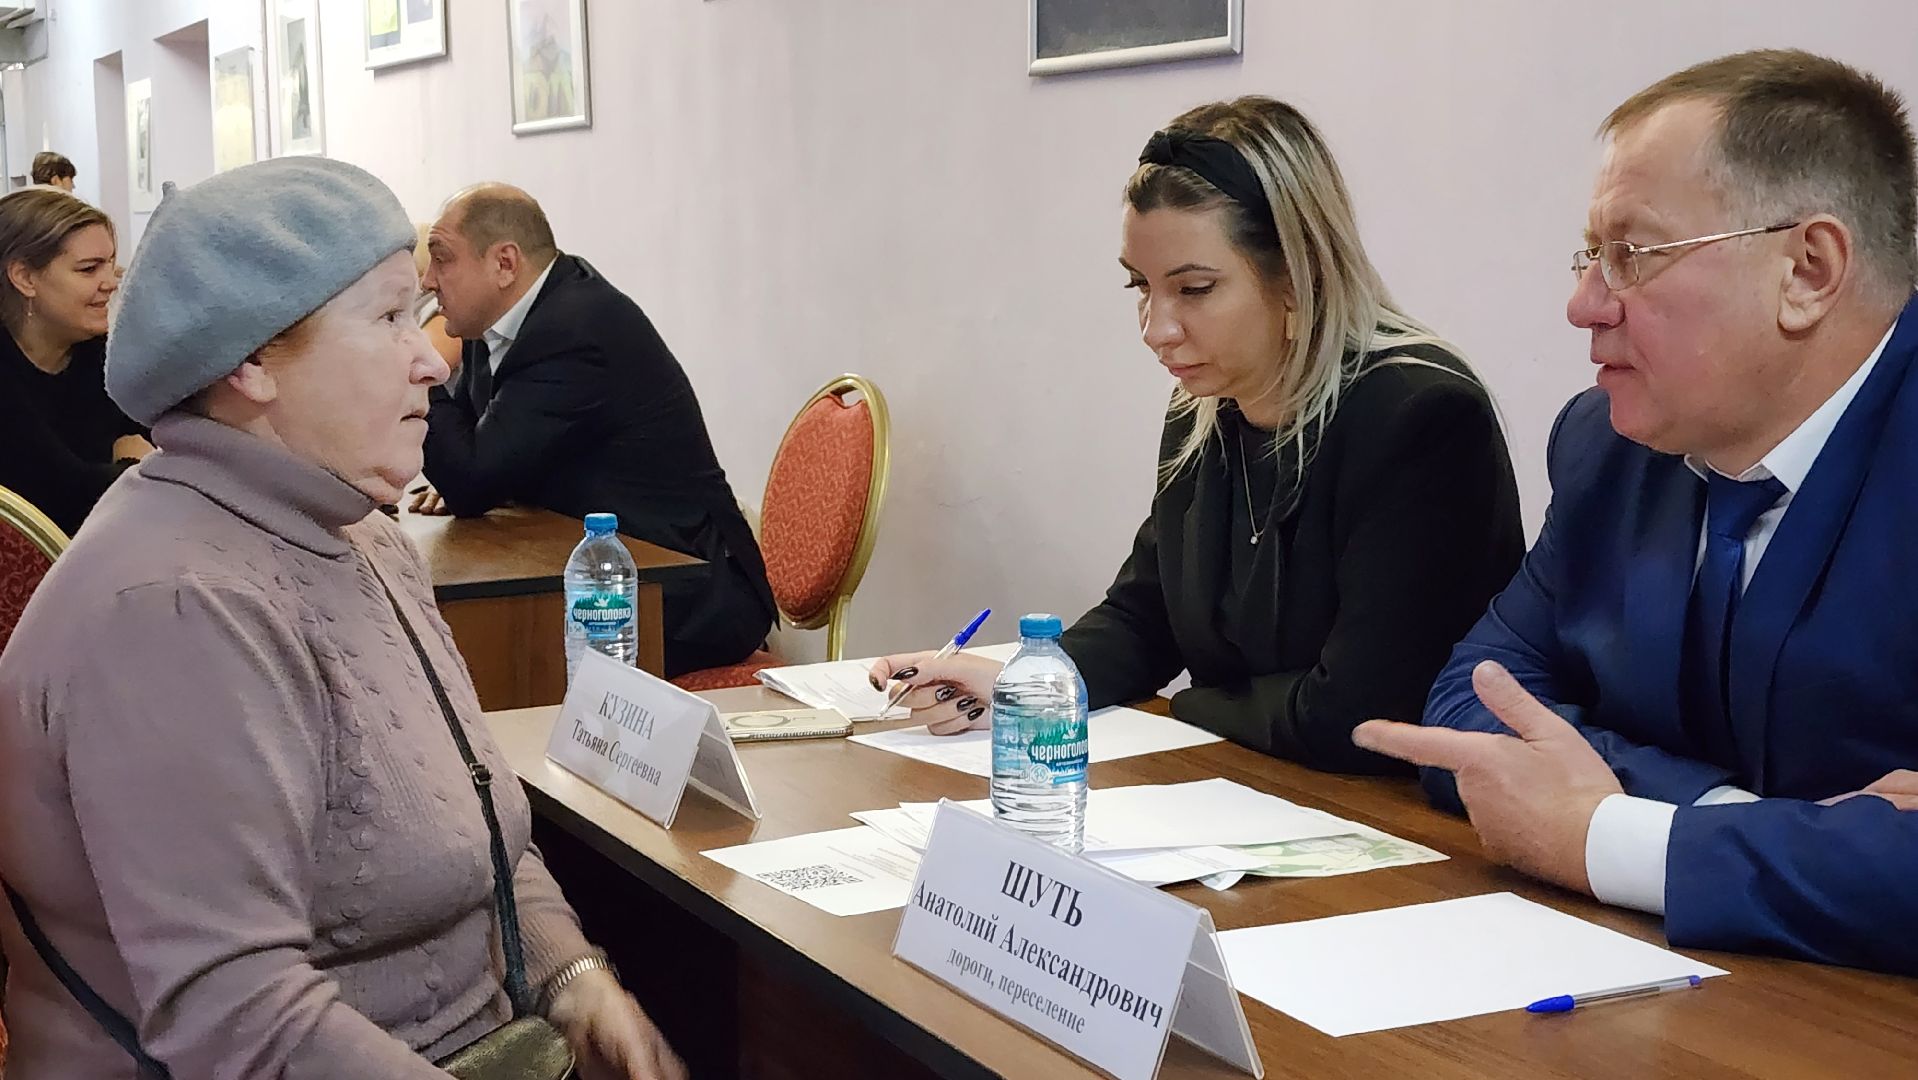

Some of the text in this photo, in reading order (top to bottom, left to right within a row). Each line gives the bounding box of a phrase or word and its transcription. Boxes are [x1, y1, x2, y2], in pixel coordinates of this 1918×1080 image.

[600, 691, 655, 740] КУЗИНА
[572, 719, 662, 787] Татьяна Сергеевна
[1001, 860, 1084, 927] ШУТЬ
[912, 880, 1164, 1029] Анатолий Александрович
[946, 949, 1086, 1034] дороги, переселение
